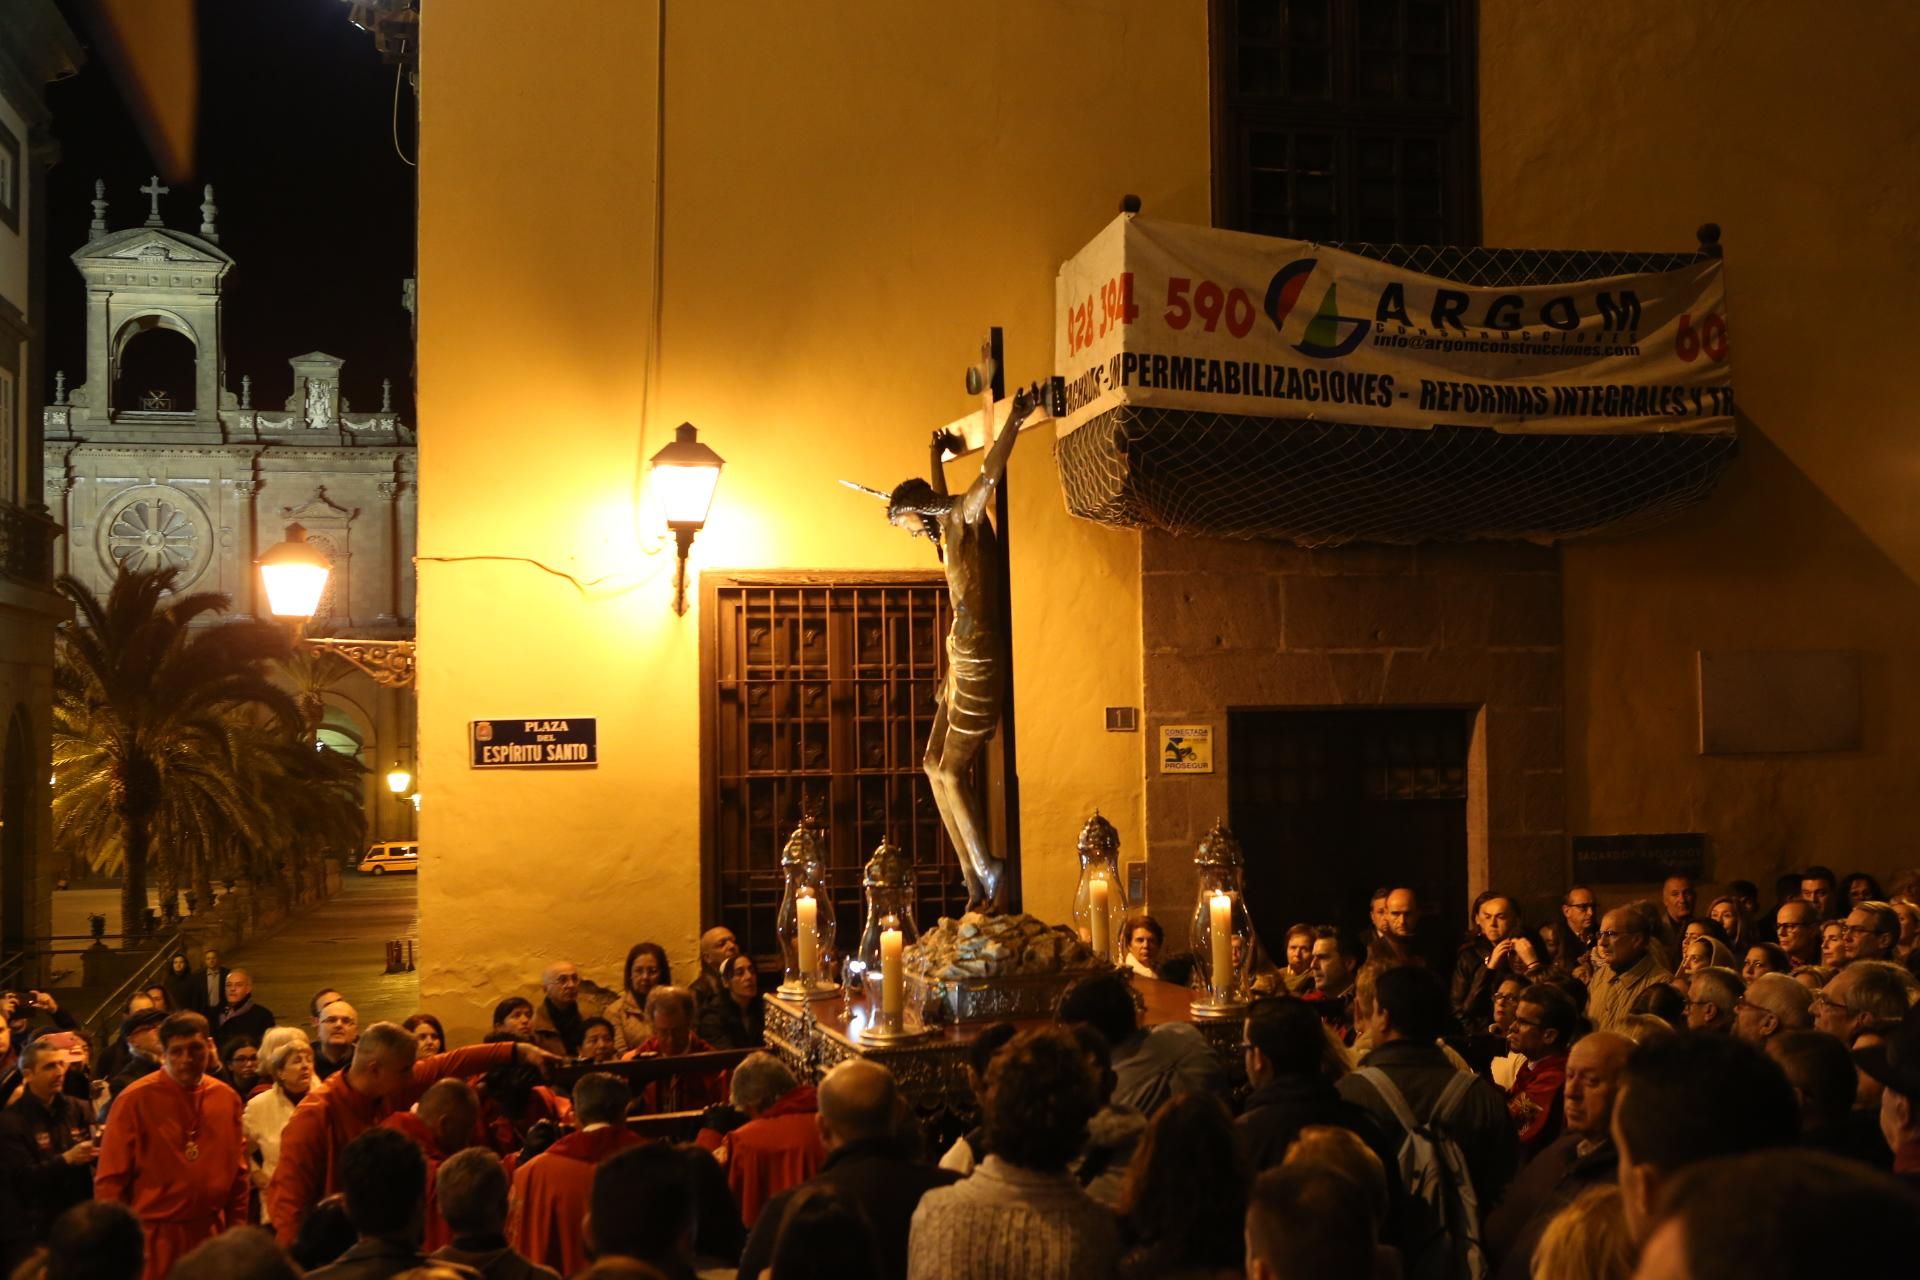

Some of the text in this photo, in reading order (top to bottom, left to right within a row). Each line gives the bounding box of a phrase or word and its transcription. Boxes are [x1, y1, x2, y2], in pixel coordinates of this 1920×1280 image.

[1068, 272, 1256, 357] 928 394 590
[1375, 281, 1642, 332] ARGOM
[1373, 333, 1641, 357] info@argomconstrucciones.com
[1419, 379, 1548, 416] REFORMAS
[1552, 384, 1688, 417] INTEGRALES
[1690, 385, 1705, 417] Y
[524, 721, 569, 733] PLAZA
[536, 734, 557, 742] DEL
[1164, 728, 1208, 737] CONECTADA
[483, 742, 588, 763] ESPÍRITU SANTO
